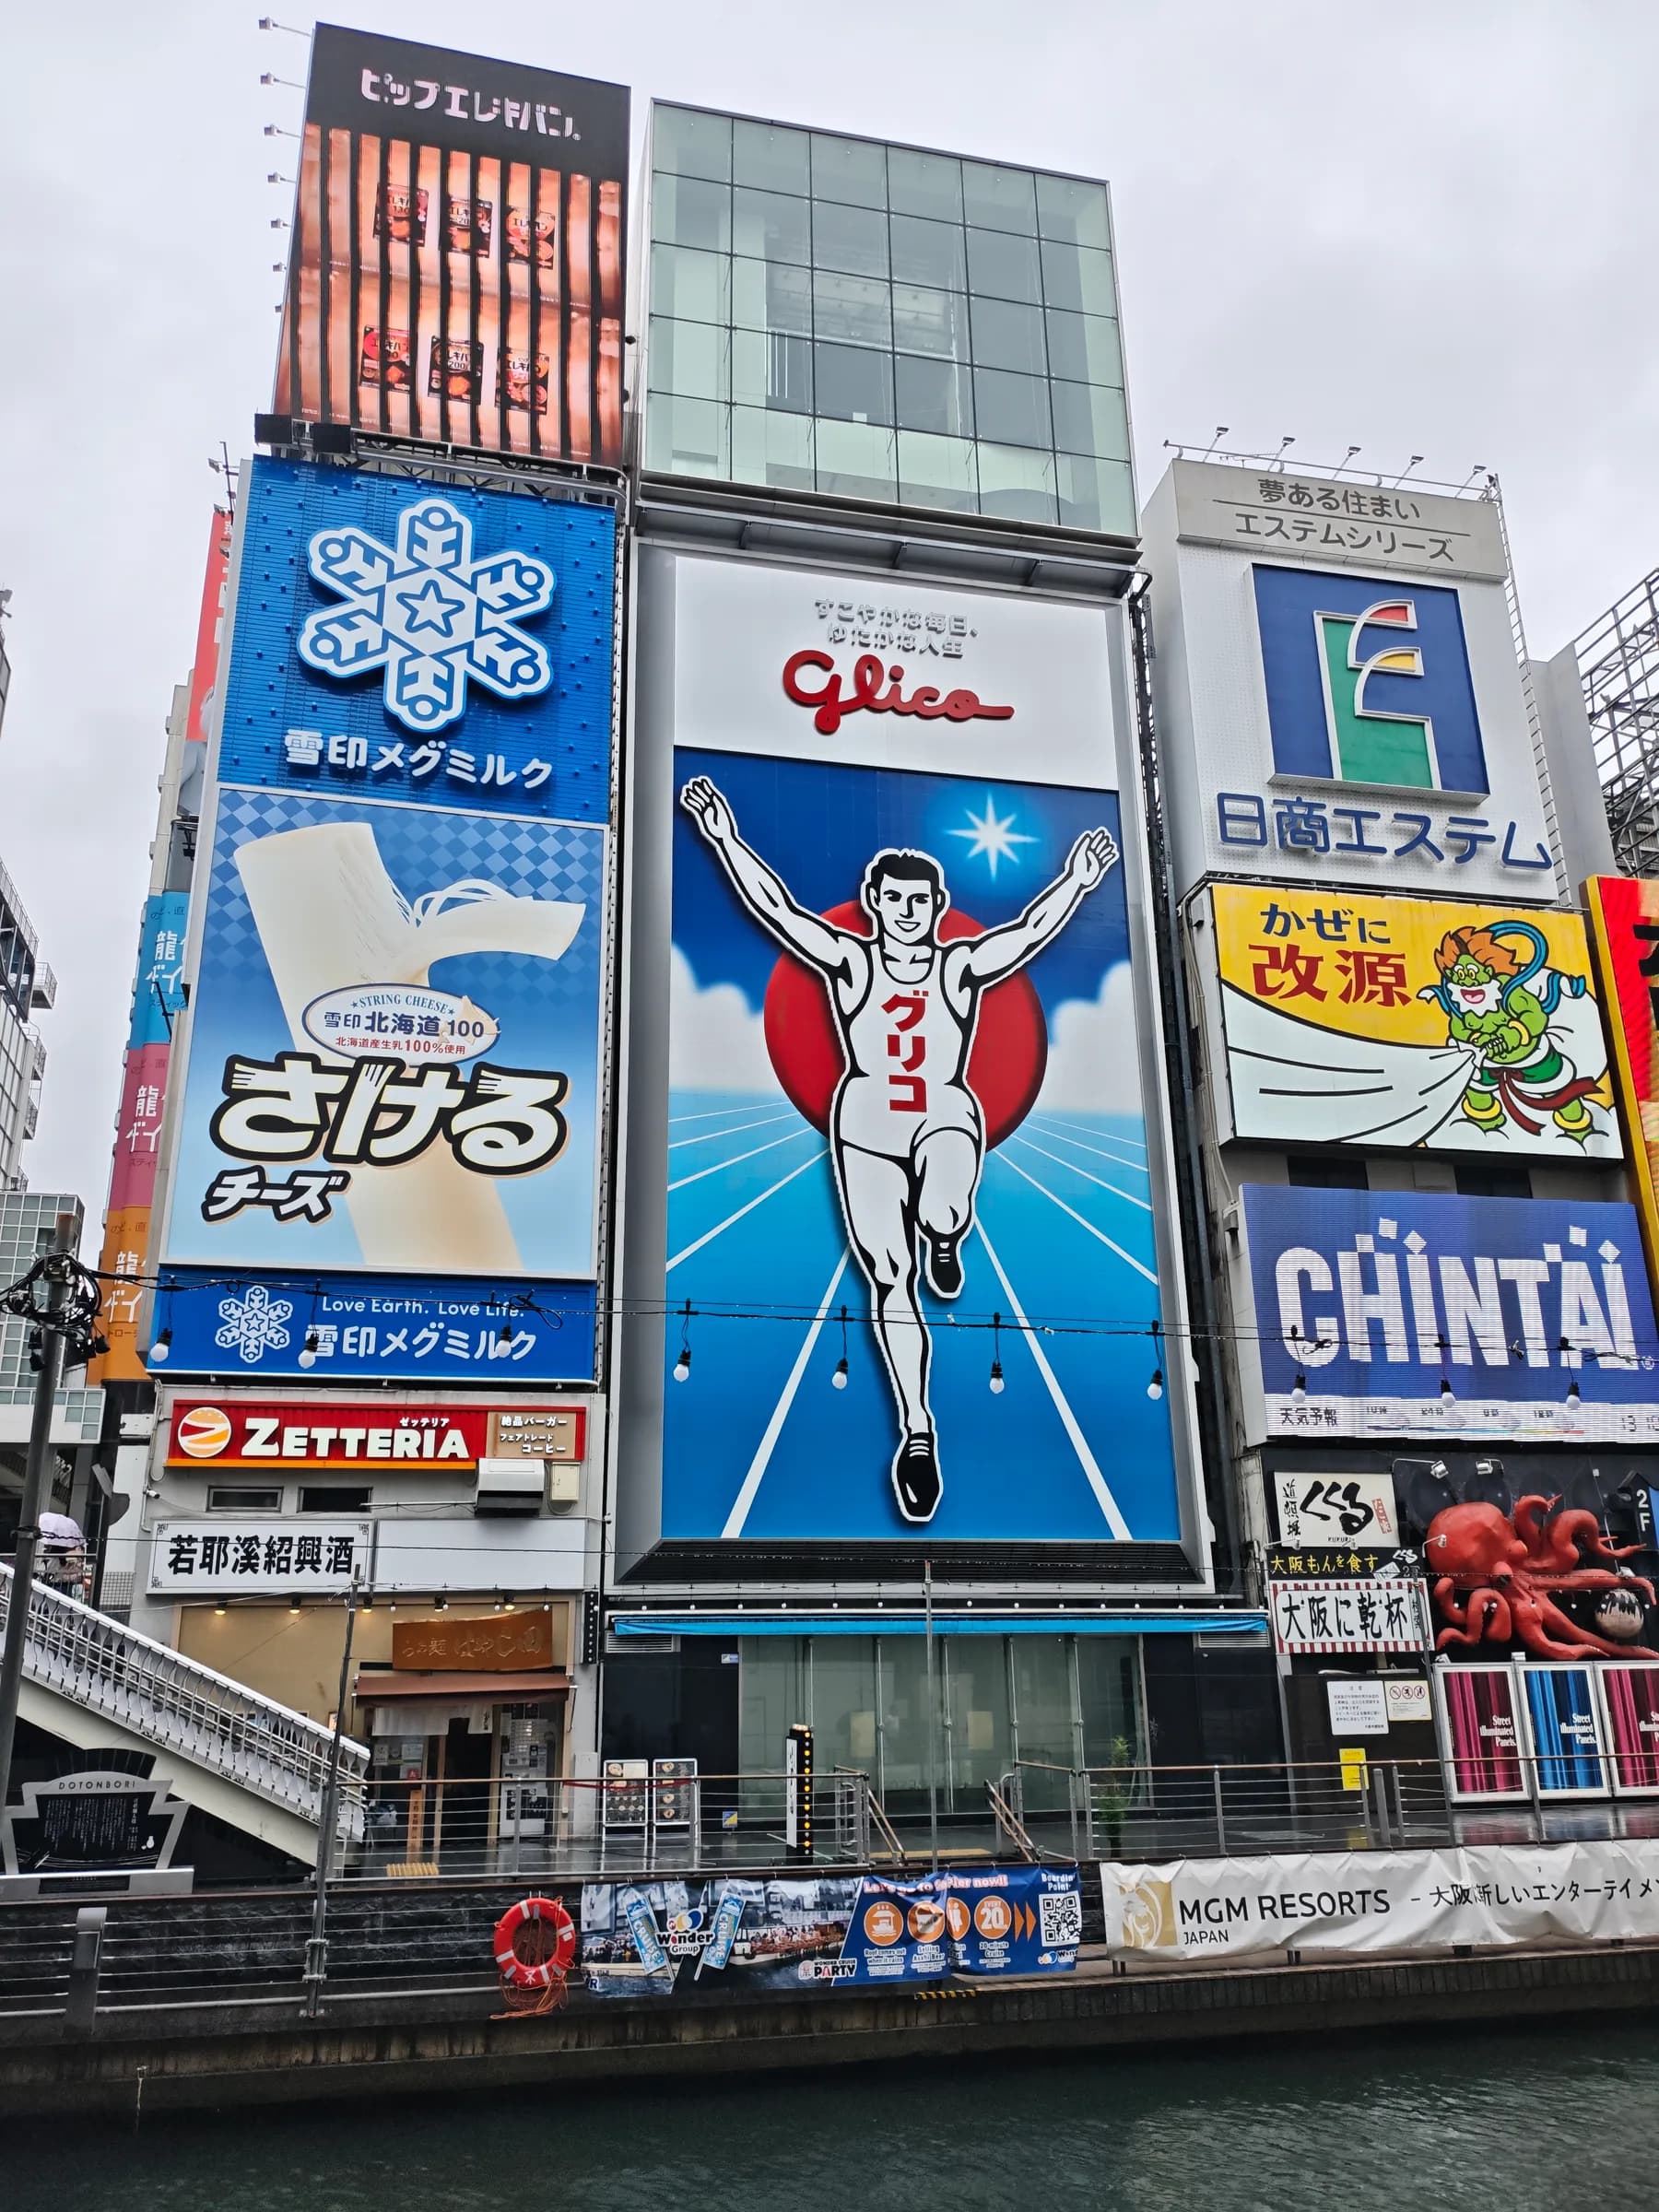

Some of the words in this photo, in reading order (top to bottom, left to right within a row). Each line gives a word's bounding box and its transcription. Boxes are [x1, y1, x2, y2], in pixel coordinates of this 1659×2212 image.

[361, 68, 575, 140] ピップエレキバン
[1257, 478, 1420, 520] 夢ある住まい
[1235, 512, 1454, 562] エステムシリーズ
[815, 599, 979, 638] すこやかな毎日、
[828, 623, 964, 659] ゆたかな人生
[782, 649, 1016, 735] Glico
[284, 728, 553, 790] 雪印メグミルク
[1217, 792, 1553, 870] 日商エステム
[1260, 902, 1392, 945] かぜに
[155, 930, 185, 961] 龍
[1248, 943, 1412, 1007] 改源
[359, 994, 401, 1008] STRING
[406, 994, 449, 1015] CHEESE
[335, 1036, 466, 1055] 北海道産生乳100%使用
[447, 1019, 485, 1039] 100
[881, 990, 929, 1112] グリコ
[135, 1085, 166, 1118] 龍
[214, 1055, 563, 1171] さける
[204, 1170, 347, 1220] チーズ
[114, 1250, 147, 1285] 龍
[322, 1295, 366, 1313] Love
[371, 1298, 429, 1315] Earth.
[438, 1300, 480, 1317] Love
[486, 1300, 524, 1318] Life.
[305, 1321, 536, 1361] 雪印メグミルク
[399, 1417, 450, 1429] ゼッテリア
[500, 1415, 568, 1427] 絶品バーガー
[1279, 1406, 1338, 1427] 天気予報
[241, 1417, 470, 1459] ZETTERIA
[500, 1432, 553, 1441] フェアトレード
[522, 1443, 567, 1454] コーヒー
[1300, 1480, 1374, 1536] くくる
[168, 1535, 356, 1576] 若耶溪紹興酒
[1270, 1552, 1379, 1574] 大阪もんを食す
[1282, 1592, 1408, 1641] 大阪に乾杯
[1479, 1724, 1514, 1736] Illuminated
[1492, 1713, 1512, 1726] Street
[1559, 1722, 1594, 1735] Illuminated
[1571, 1712, 1592, 1724] Street
[58, 1780, 136, 1790] DOTONBORI
[1179, 1896, 1249, 1925] MGM
[1257, 1888, 1391, 1920] RESORTS
[656, 1932, 713, 1946] Wonder
[671, 1945, 700, 1955] Group
[1183, 1928, 1230, 1946] JAPAN
[814, 1964, 855, 1977] PARTY
